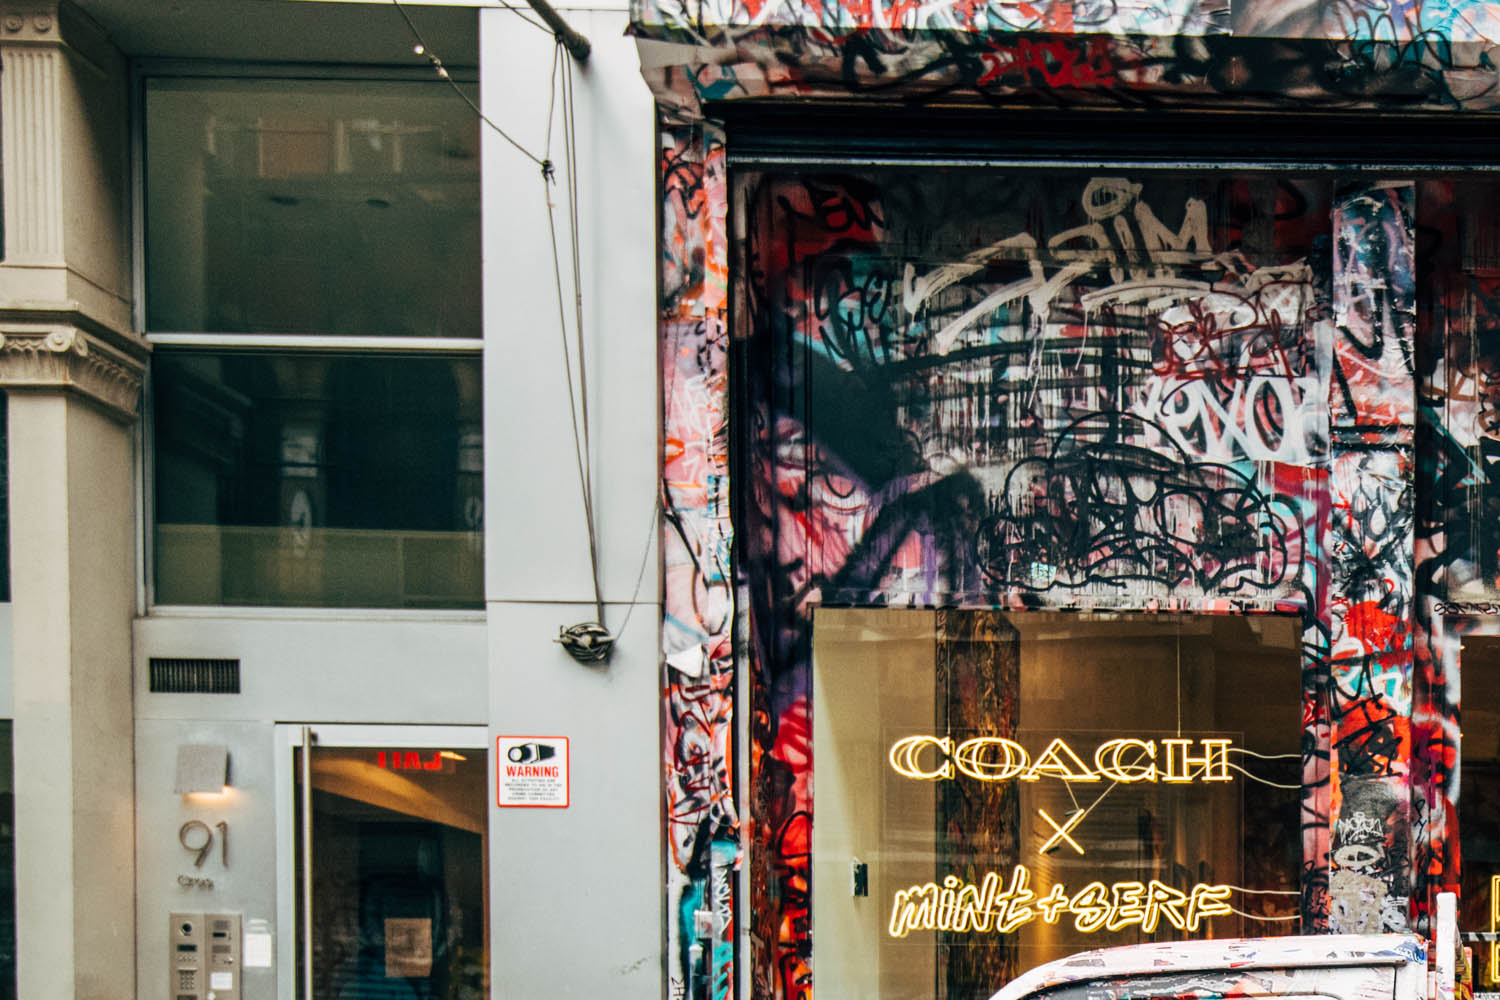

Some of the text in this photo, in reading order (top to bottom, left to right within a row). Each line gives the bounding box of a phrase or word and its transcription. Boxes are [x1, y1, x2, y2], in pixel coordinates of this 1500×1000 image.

[505, 765, 559, 778] WARNING
[888, 734, 1234, 784] COACH
[179, 820, 229, 869] 91
